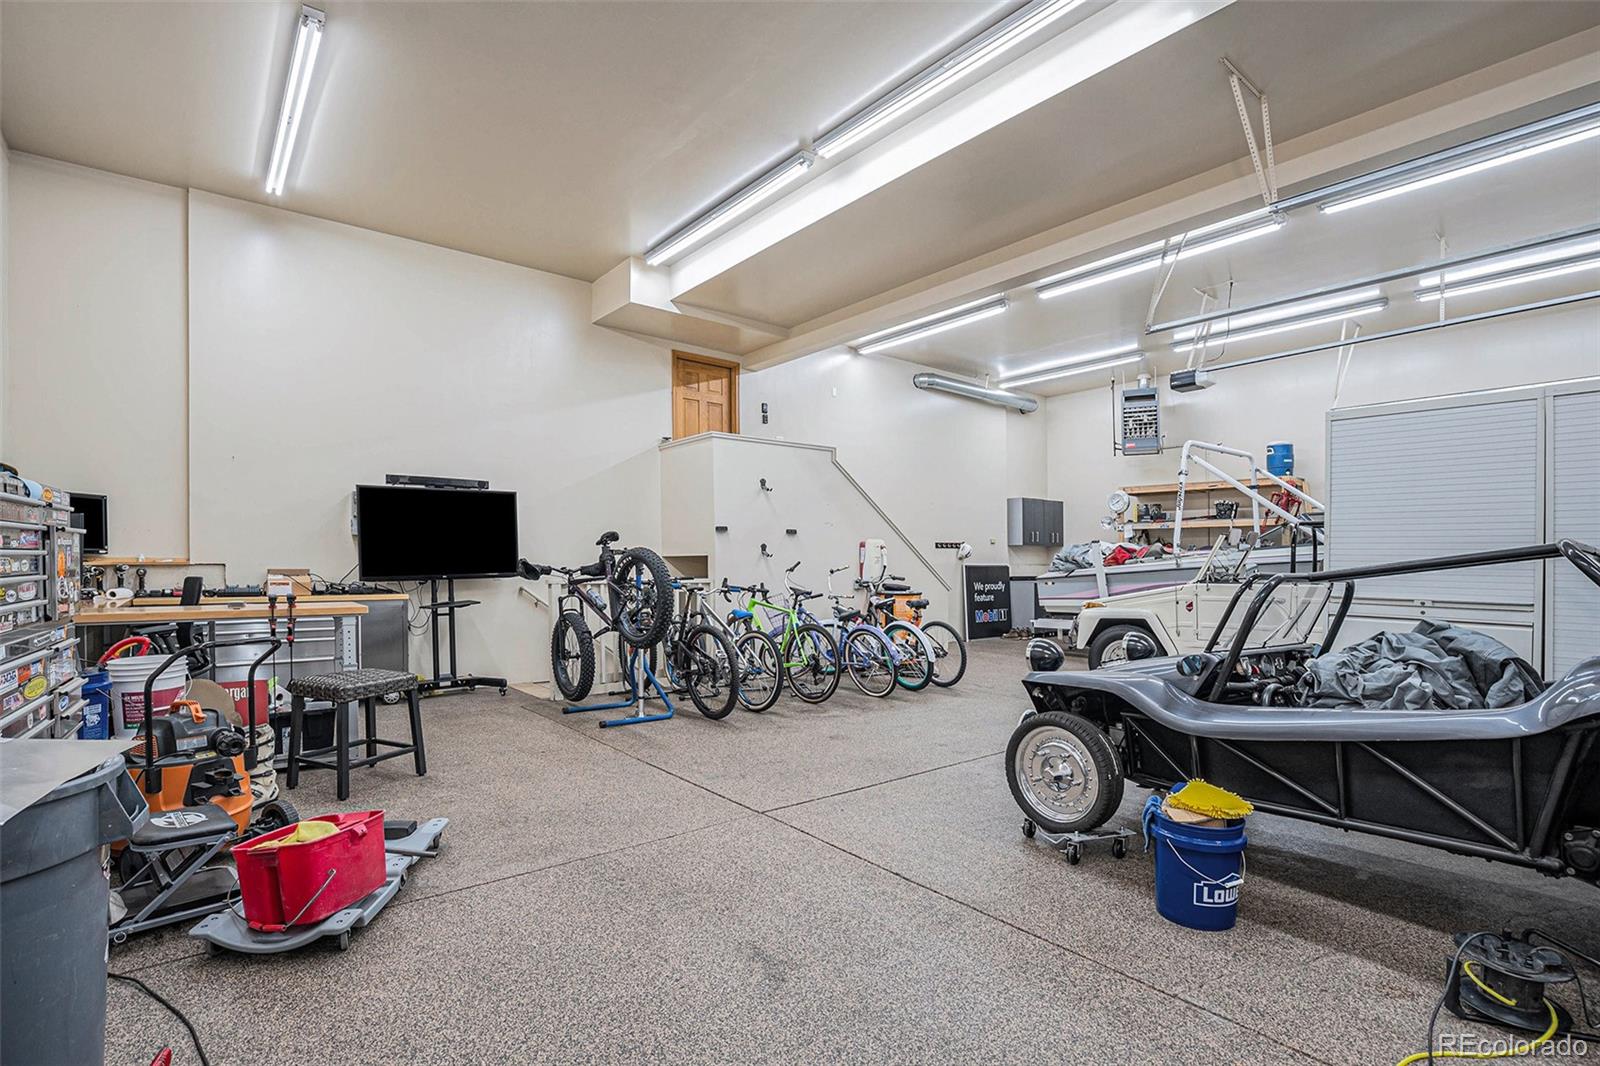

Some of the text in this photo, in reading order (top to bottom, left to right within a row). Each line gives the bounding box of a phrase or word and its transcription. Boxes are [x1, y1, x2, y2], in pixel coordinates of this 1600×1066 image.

[973, 581, 1005, 592] We proudly
[974, 593, 994, 602] feature
[975, 608, 998, 622] Mobil
